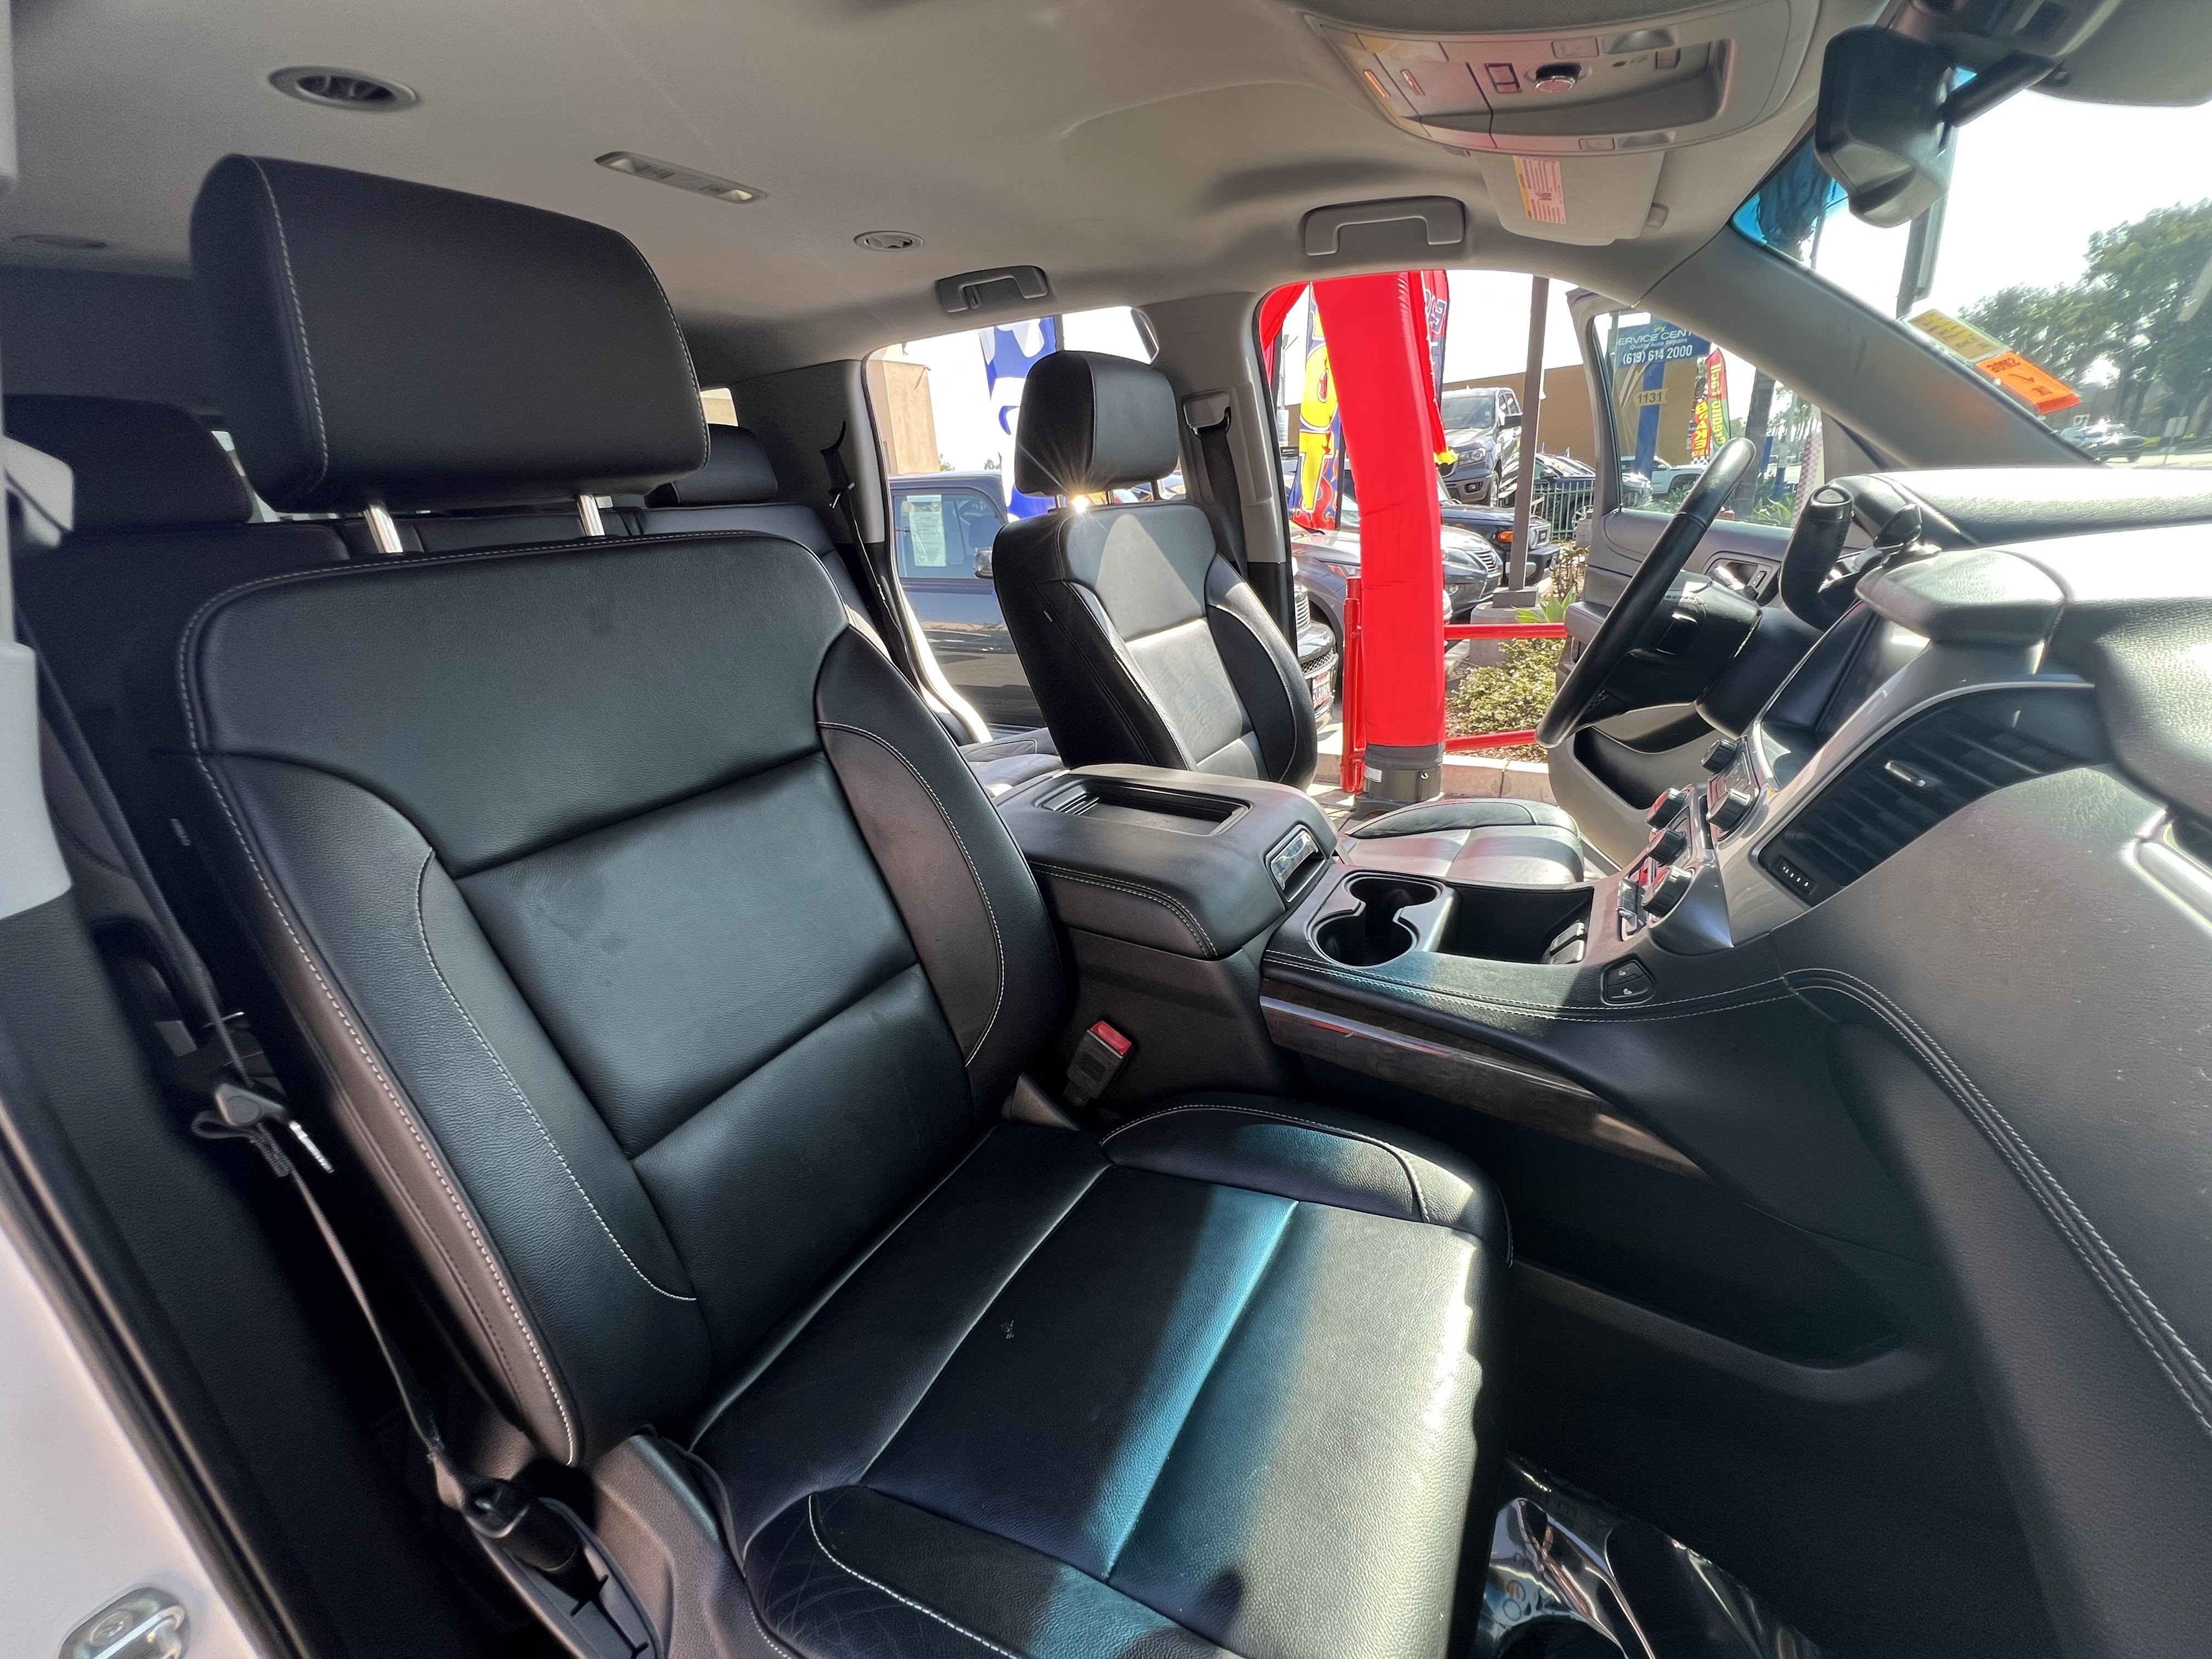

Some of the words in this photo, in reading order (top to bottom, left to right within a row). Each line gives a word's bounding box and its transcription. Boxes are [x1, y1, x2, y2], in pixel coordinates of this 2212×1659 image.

[1618, 333, 1658, 346] ERVICE
[1623, 351, 1645, 364] (619)
[1648, 348, 1664, 362] 614
[1666, 345, 1693, 359] 2000
[1637, 391, 1662, 404] 1131
